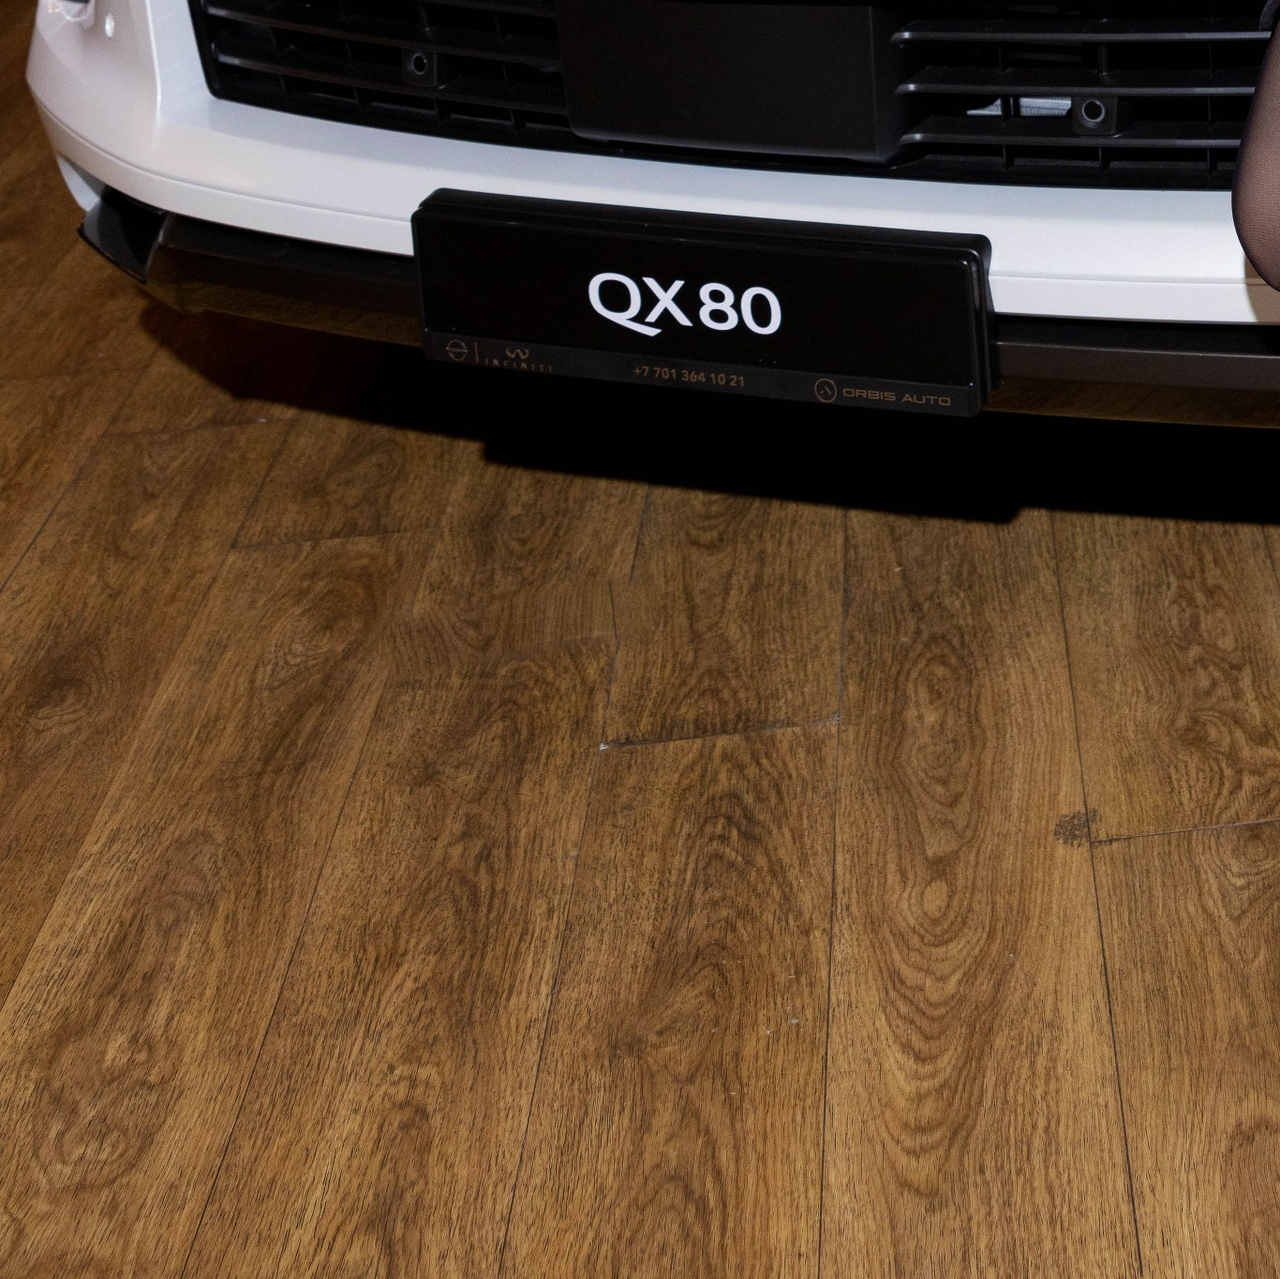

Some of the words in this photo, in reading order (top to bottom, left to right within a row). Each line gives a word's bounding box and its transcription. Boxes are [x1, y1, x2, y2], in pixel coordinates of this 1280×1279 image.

[588, 272, 782, 337] QX80
[633, 365, 650, 377] +7
[653, 367, 677, 380] 701
[681, 370, 706, 383] 364
[710, 373, 726, 386] 10
[730, 375, 745, 387] 21
[842, 388, 896, 402] ORBIS
[902, 393, 951, 407] AUTO
